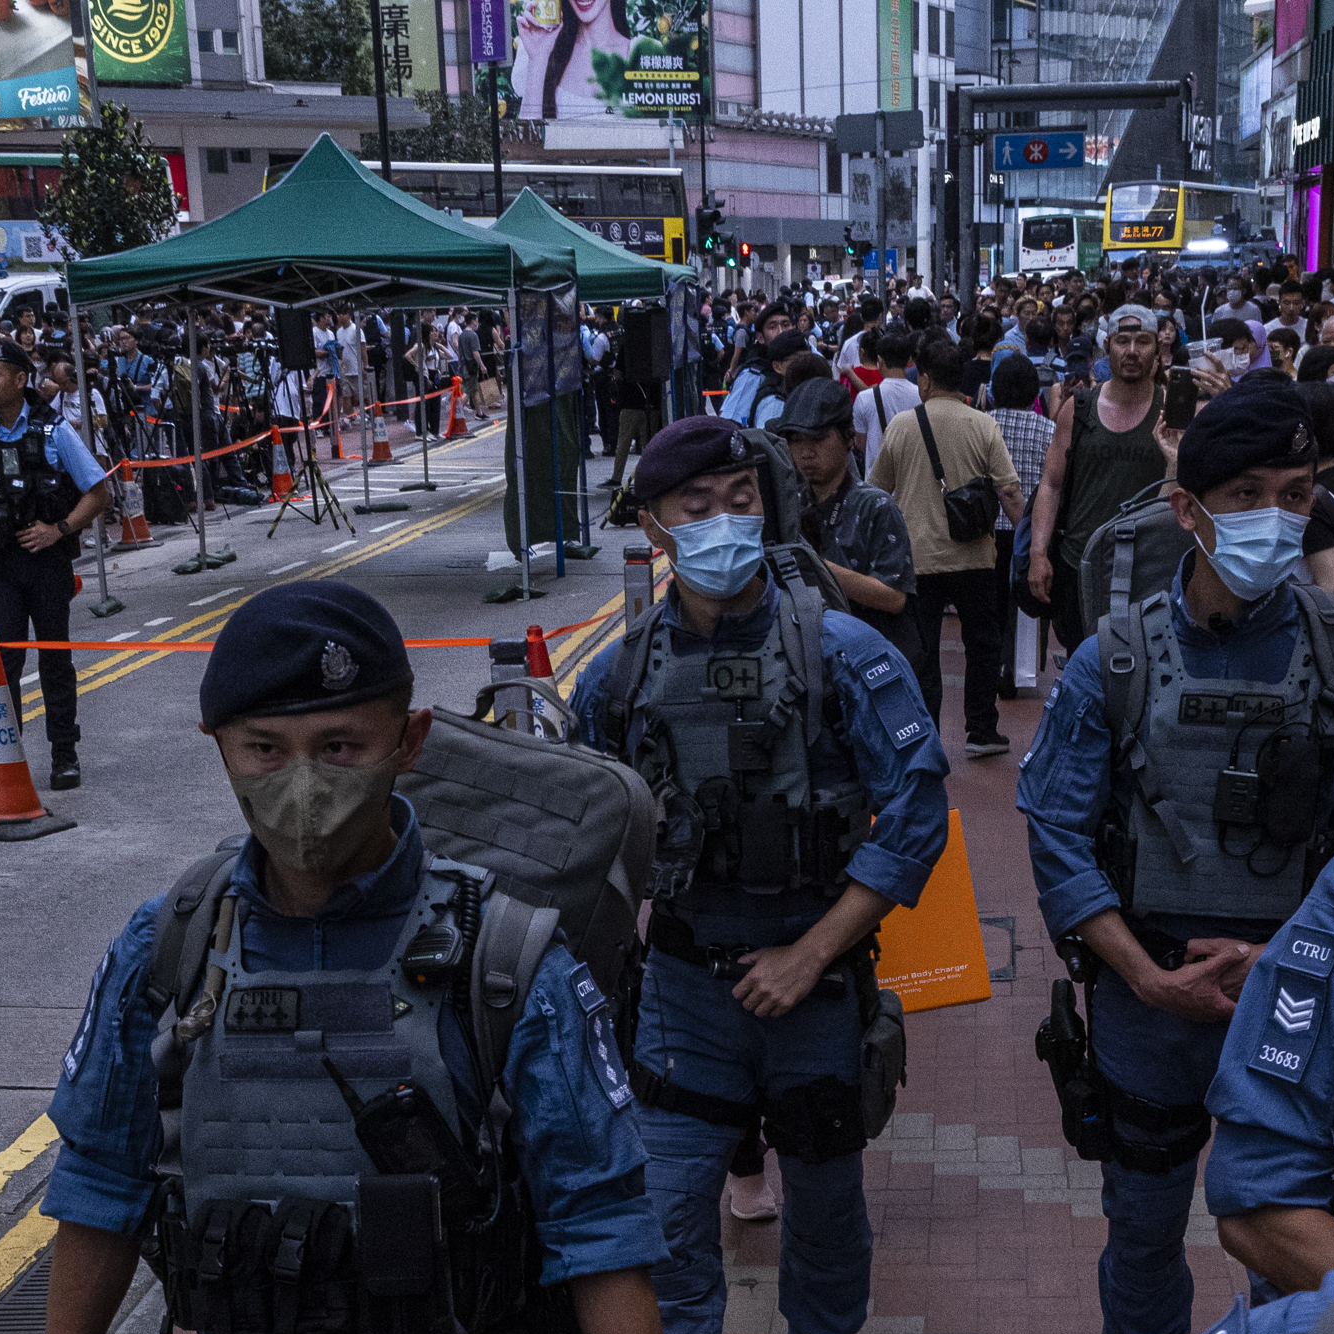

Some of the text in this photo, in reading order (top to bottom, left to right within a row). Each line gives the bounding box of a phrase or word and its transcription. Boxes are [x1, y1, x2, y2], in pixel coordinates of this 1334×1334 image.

[91, 2, 168, 54] SINCE 1903
[485, 14, 495, 56] KONG
[18, 85, 71, 111] Festiva
[622, 92, 664, 105] LEMON
[990, 173, 1004, 185] CHAEL
[1151, 225, 1164, 238] 77
[866, 660, 892, 682] CTRU
[1182, 698, 1226, 720] B+
[896, 722, 922, 742] 13373
[1291, 940, 1332, 963] CTRU
[877, 963, 969, 985] Natural Body Charger
[919, 975, 946, 985] Recharge
[239, 990, 283, 1007] CTRU
[578, 979, 595, 998] CTRU
[1259, 1045, 1301, 1071] 33683
